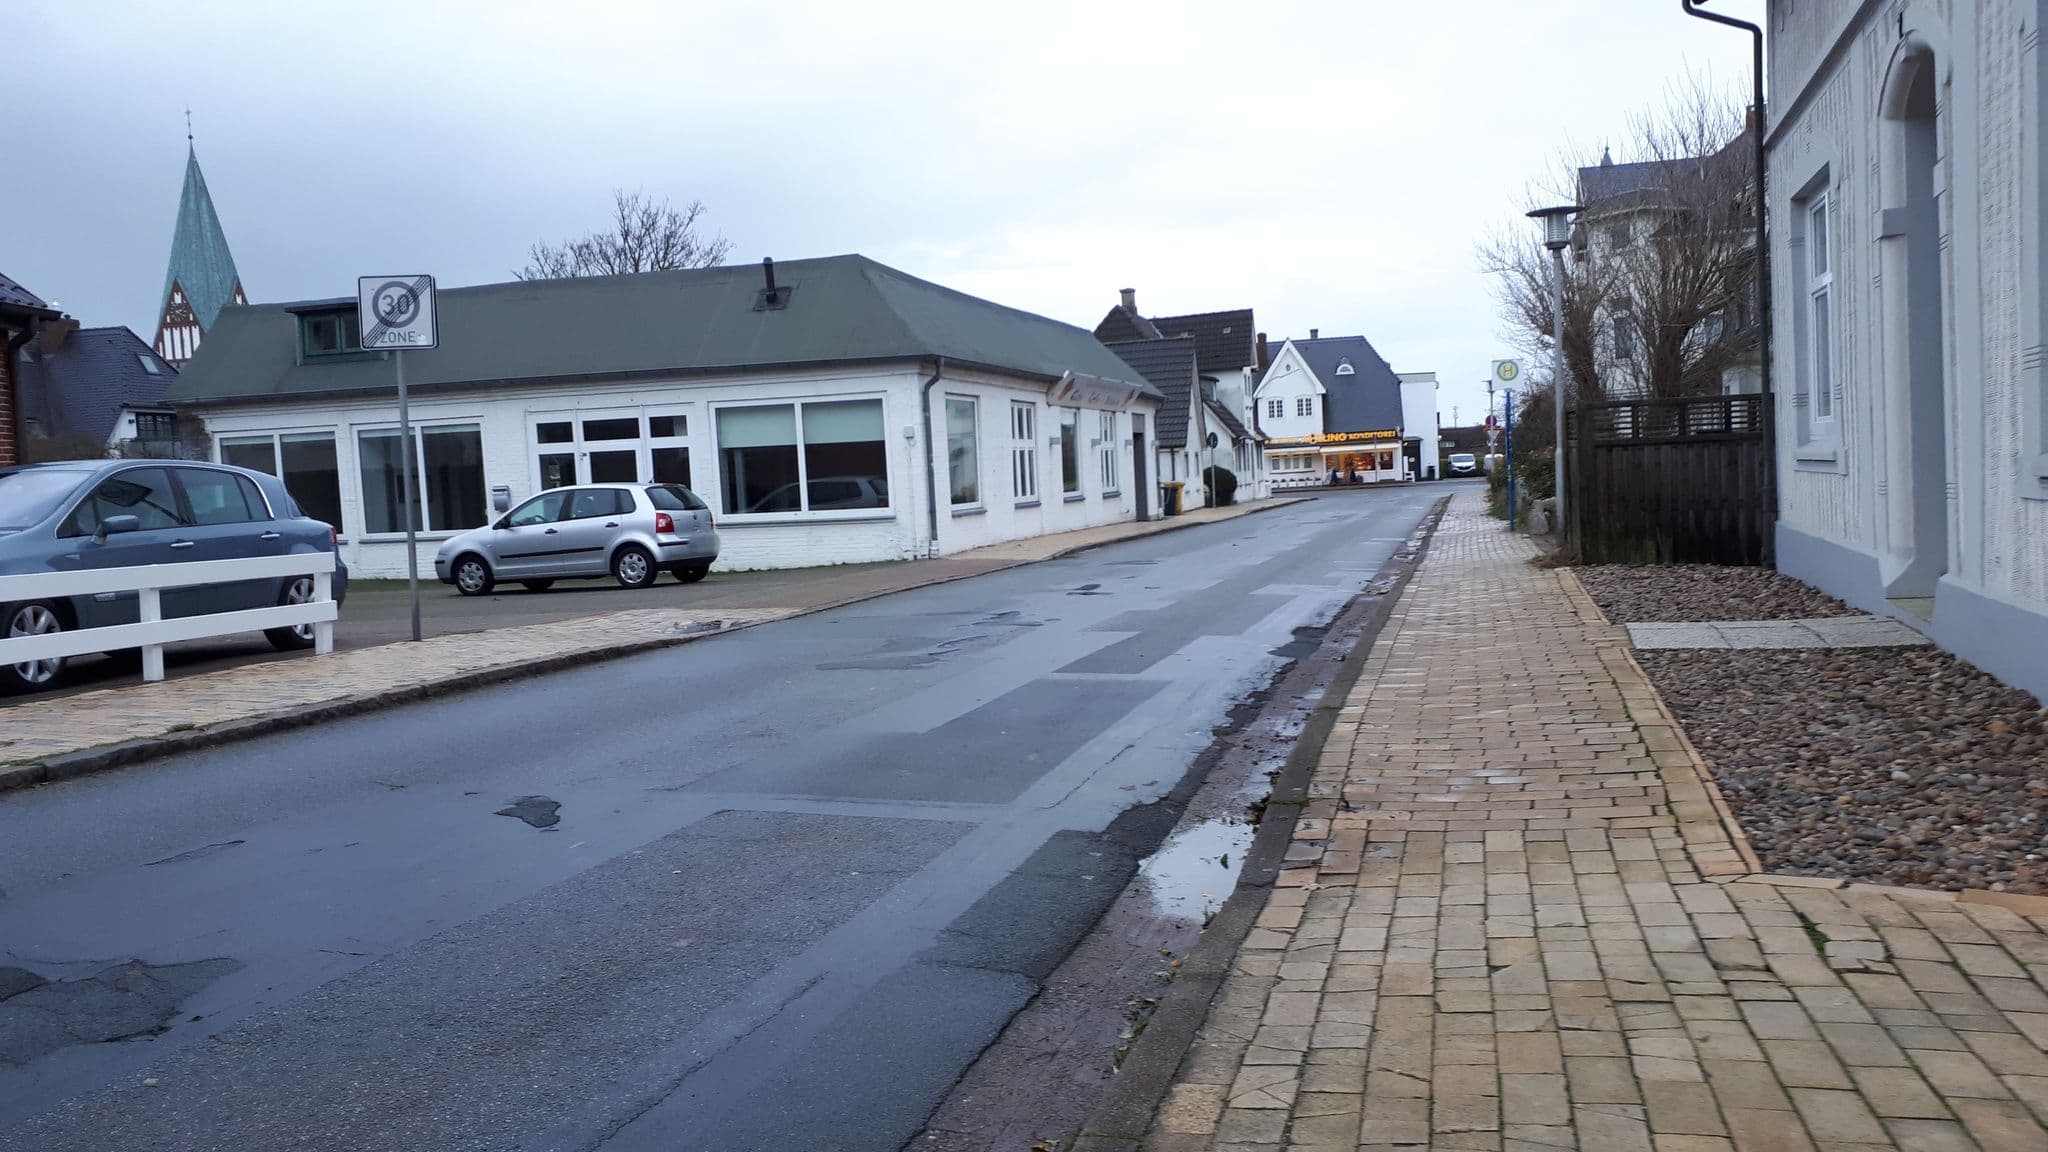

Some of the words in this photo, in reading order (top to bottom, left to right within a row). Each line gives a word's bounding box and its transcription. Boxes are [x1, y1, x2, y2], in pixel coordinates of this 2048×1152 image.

[382, 294, 411, 315] 30
[380, 330, 416, 344] ZONE
[1503, 365, 1513, 377] H
